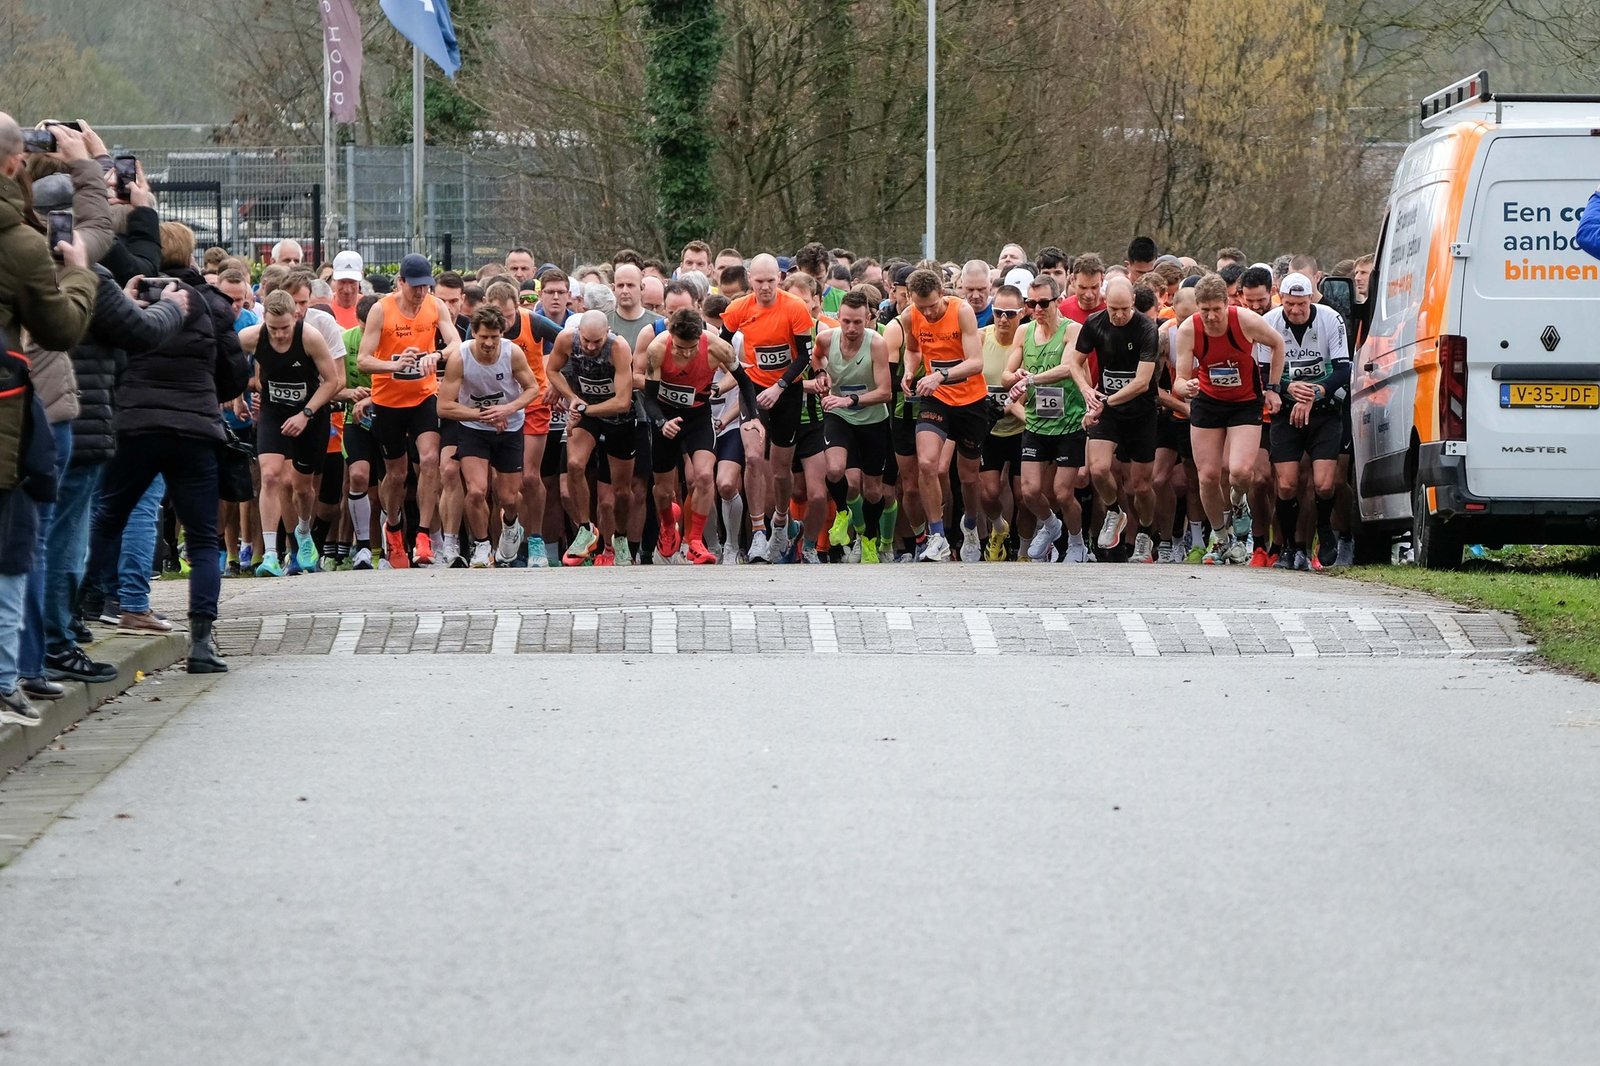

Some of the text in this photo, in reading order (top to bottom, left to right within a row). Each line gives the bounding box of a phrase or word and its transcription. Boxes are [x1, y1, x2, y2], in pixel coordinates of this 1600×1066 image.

[1503, 202, 1551, 222] Een
[1505, 258, 1598, 280] binnen
[760, 351, 787, 364] 095
[274, 389, 301, 400] 099
[584, 384, 611, 394] 203
[662, 388, 688, 403] 196
[1516, 386, 1592, 402] V-35-JDF
[1042, 398, 1057, 408] 16
[1501, 446, 1568, 454] MASTER
